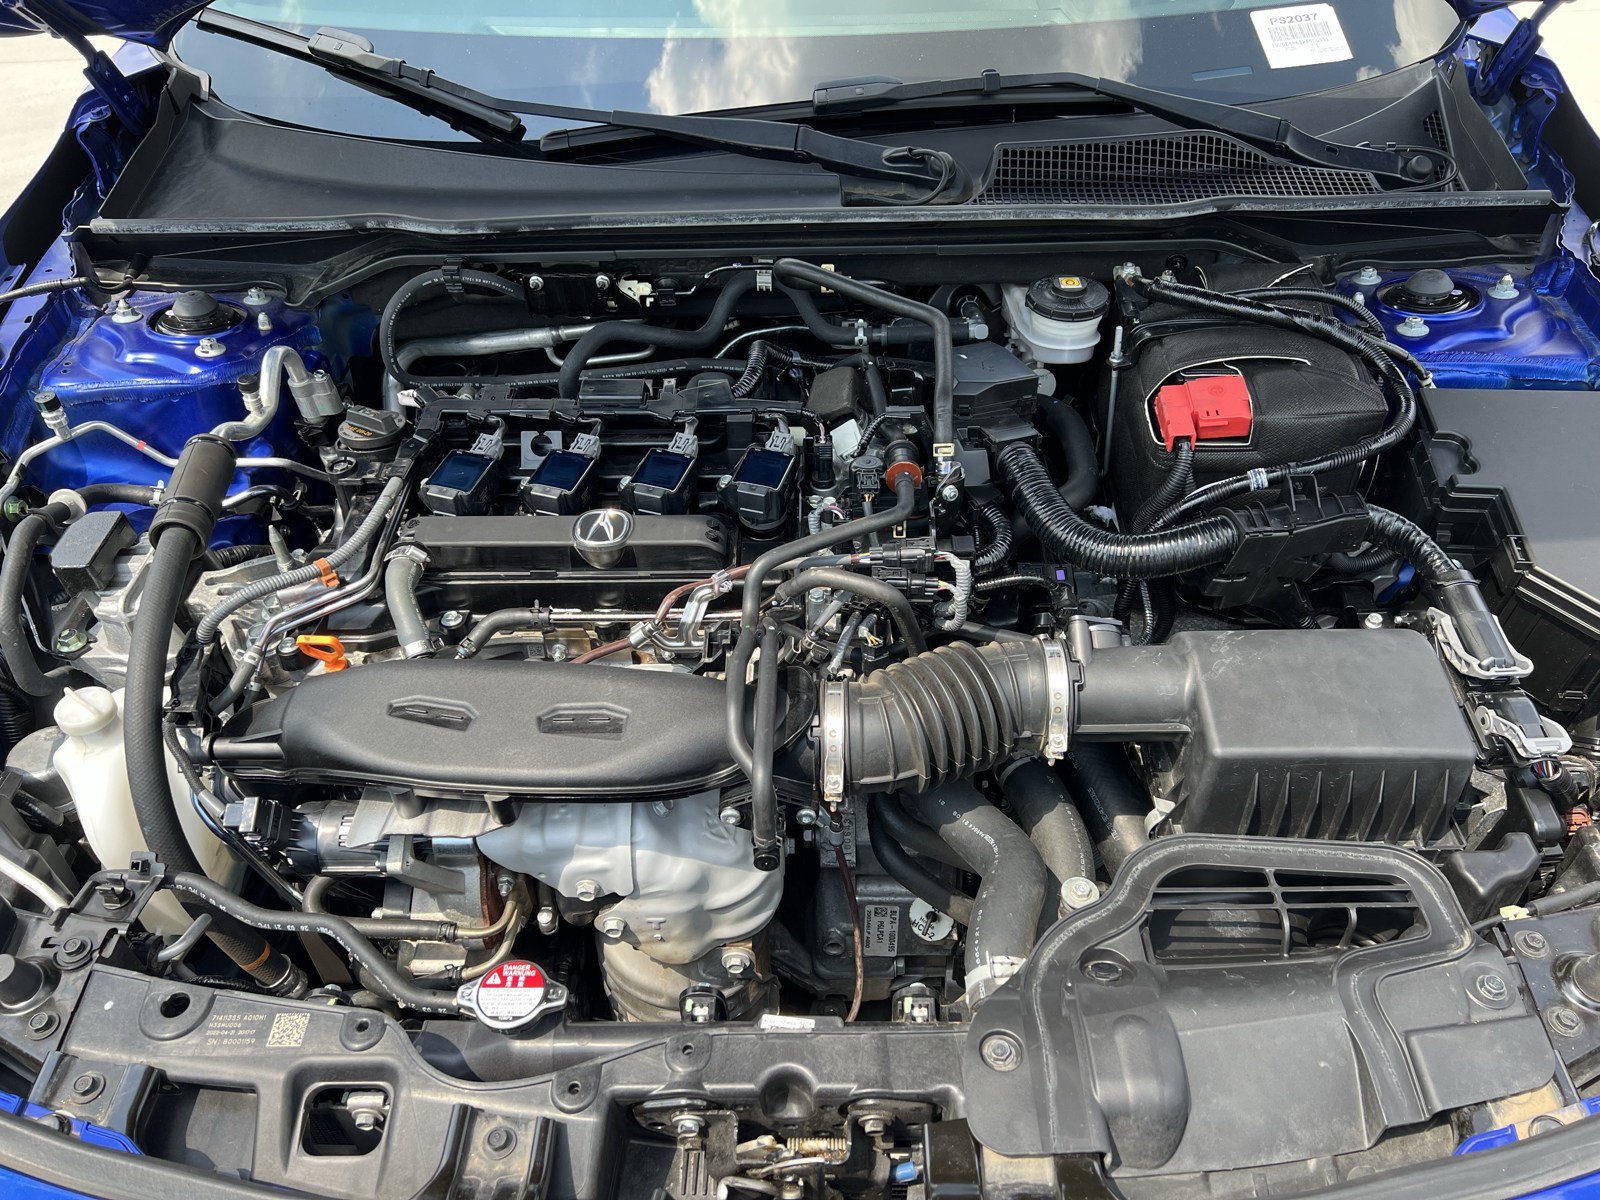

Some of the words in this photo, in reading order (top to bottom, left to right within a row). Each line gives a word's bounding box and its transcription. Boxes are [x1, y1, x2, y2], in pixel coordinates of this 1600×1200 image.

[1270, 13, 1318, 25] PS2037
[911, 919, 936, 940] HC-2
[207, 1038, 220, 1046] SN:
